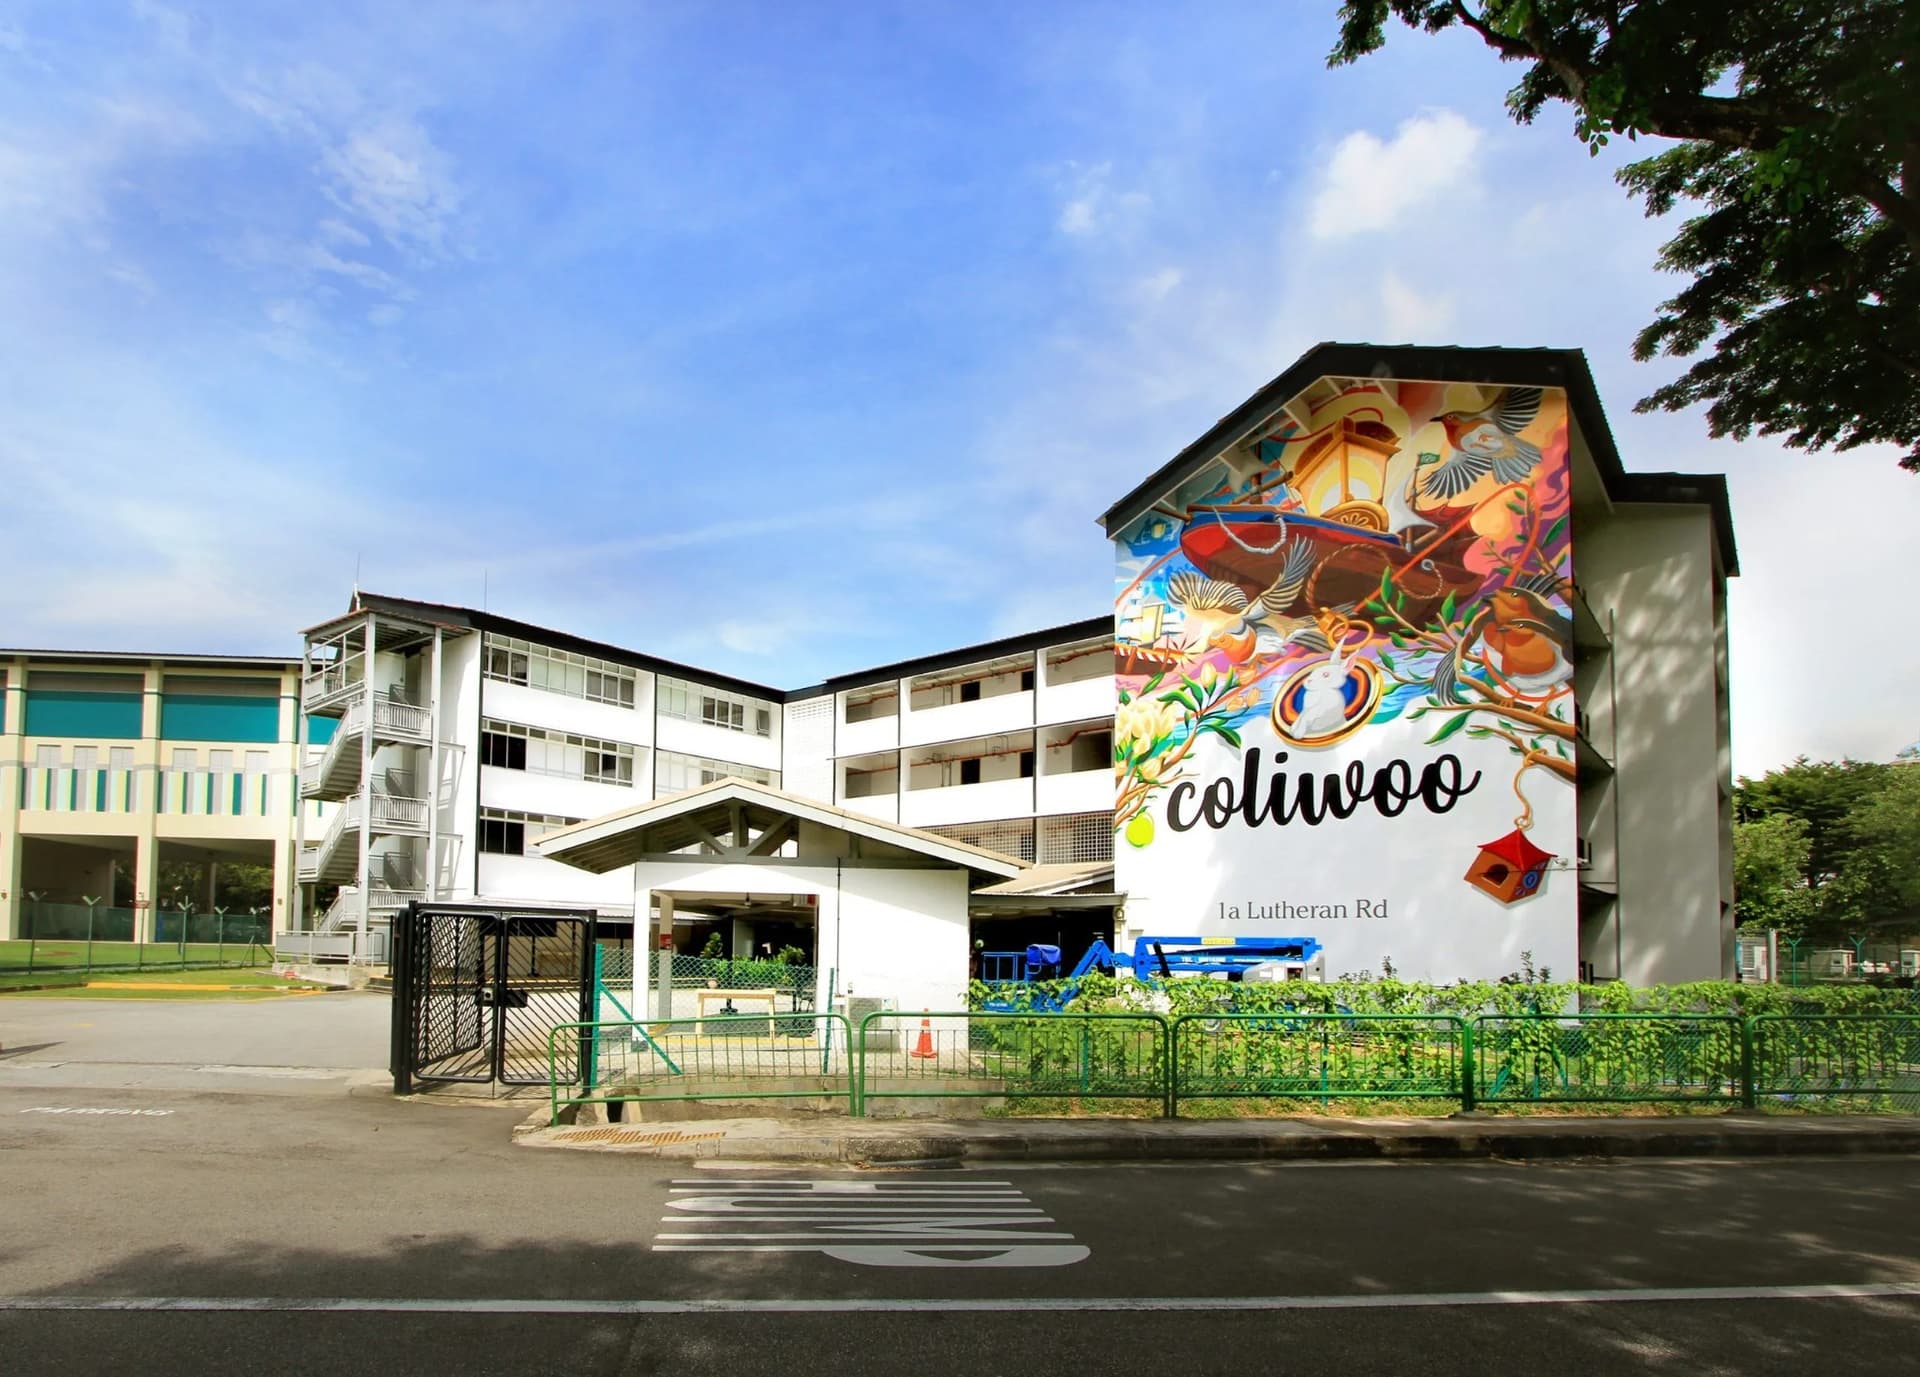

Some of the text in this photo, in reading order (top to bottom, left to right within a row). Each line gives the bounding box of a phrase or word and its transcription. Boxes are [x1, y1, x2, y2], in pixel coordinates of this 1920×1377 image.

[1167, 747, 1482, 832] coliwoo
[1247, 901, 1348, 919] Lutheran
[1356, 899, 1388, 918] Rd
[651, 1179, 1091, 1268] HUMP
